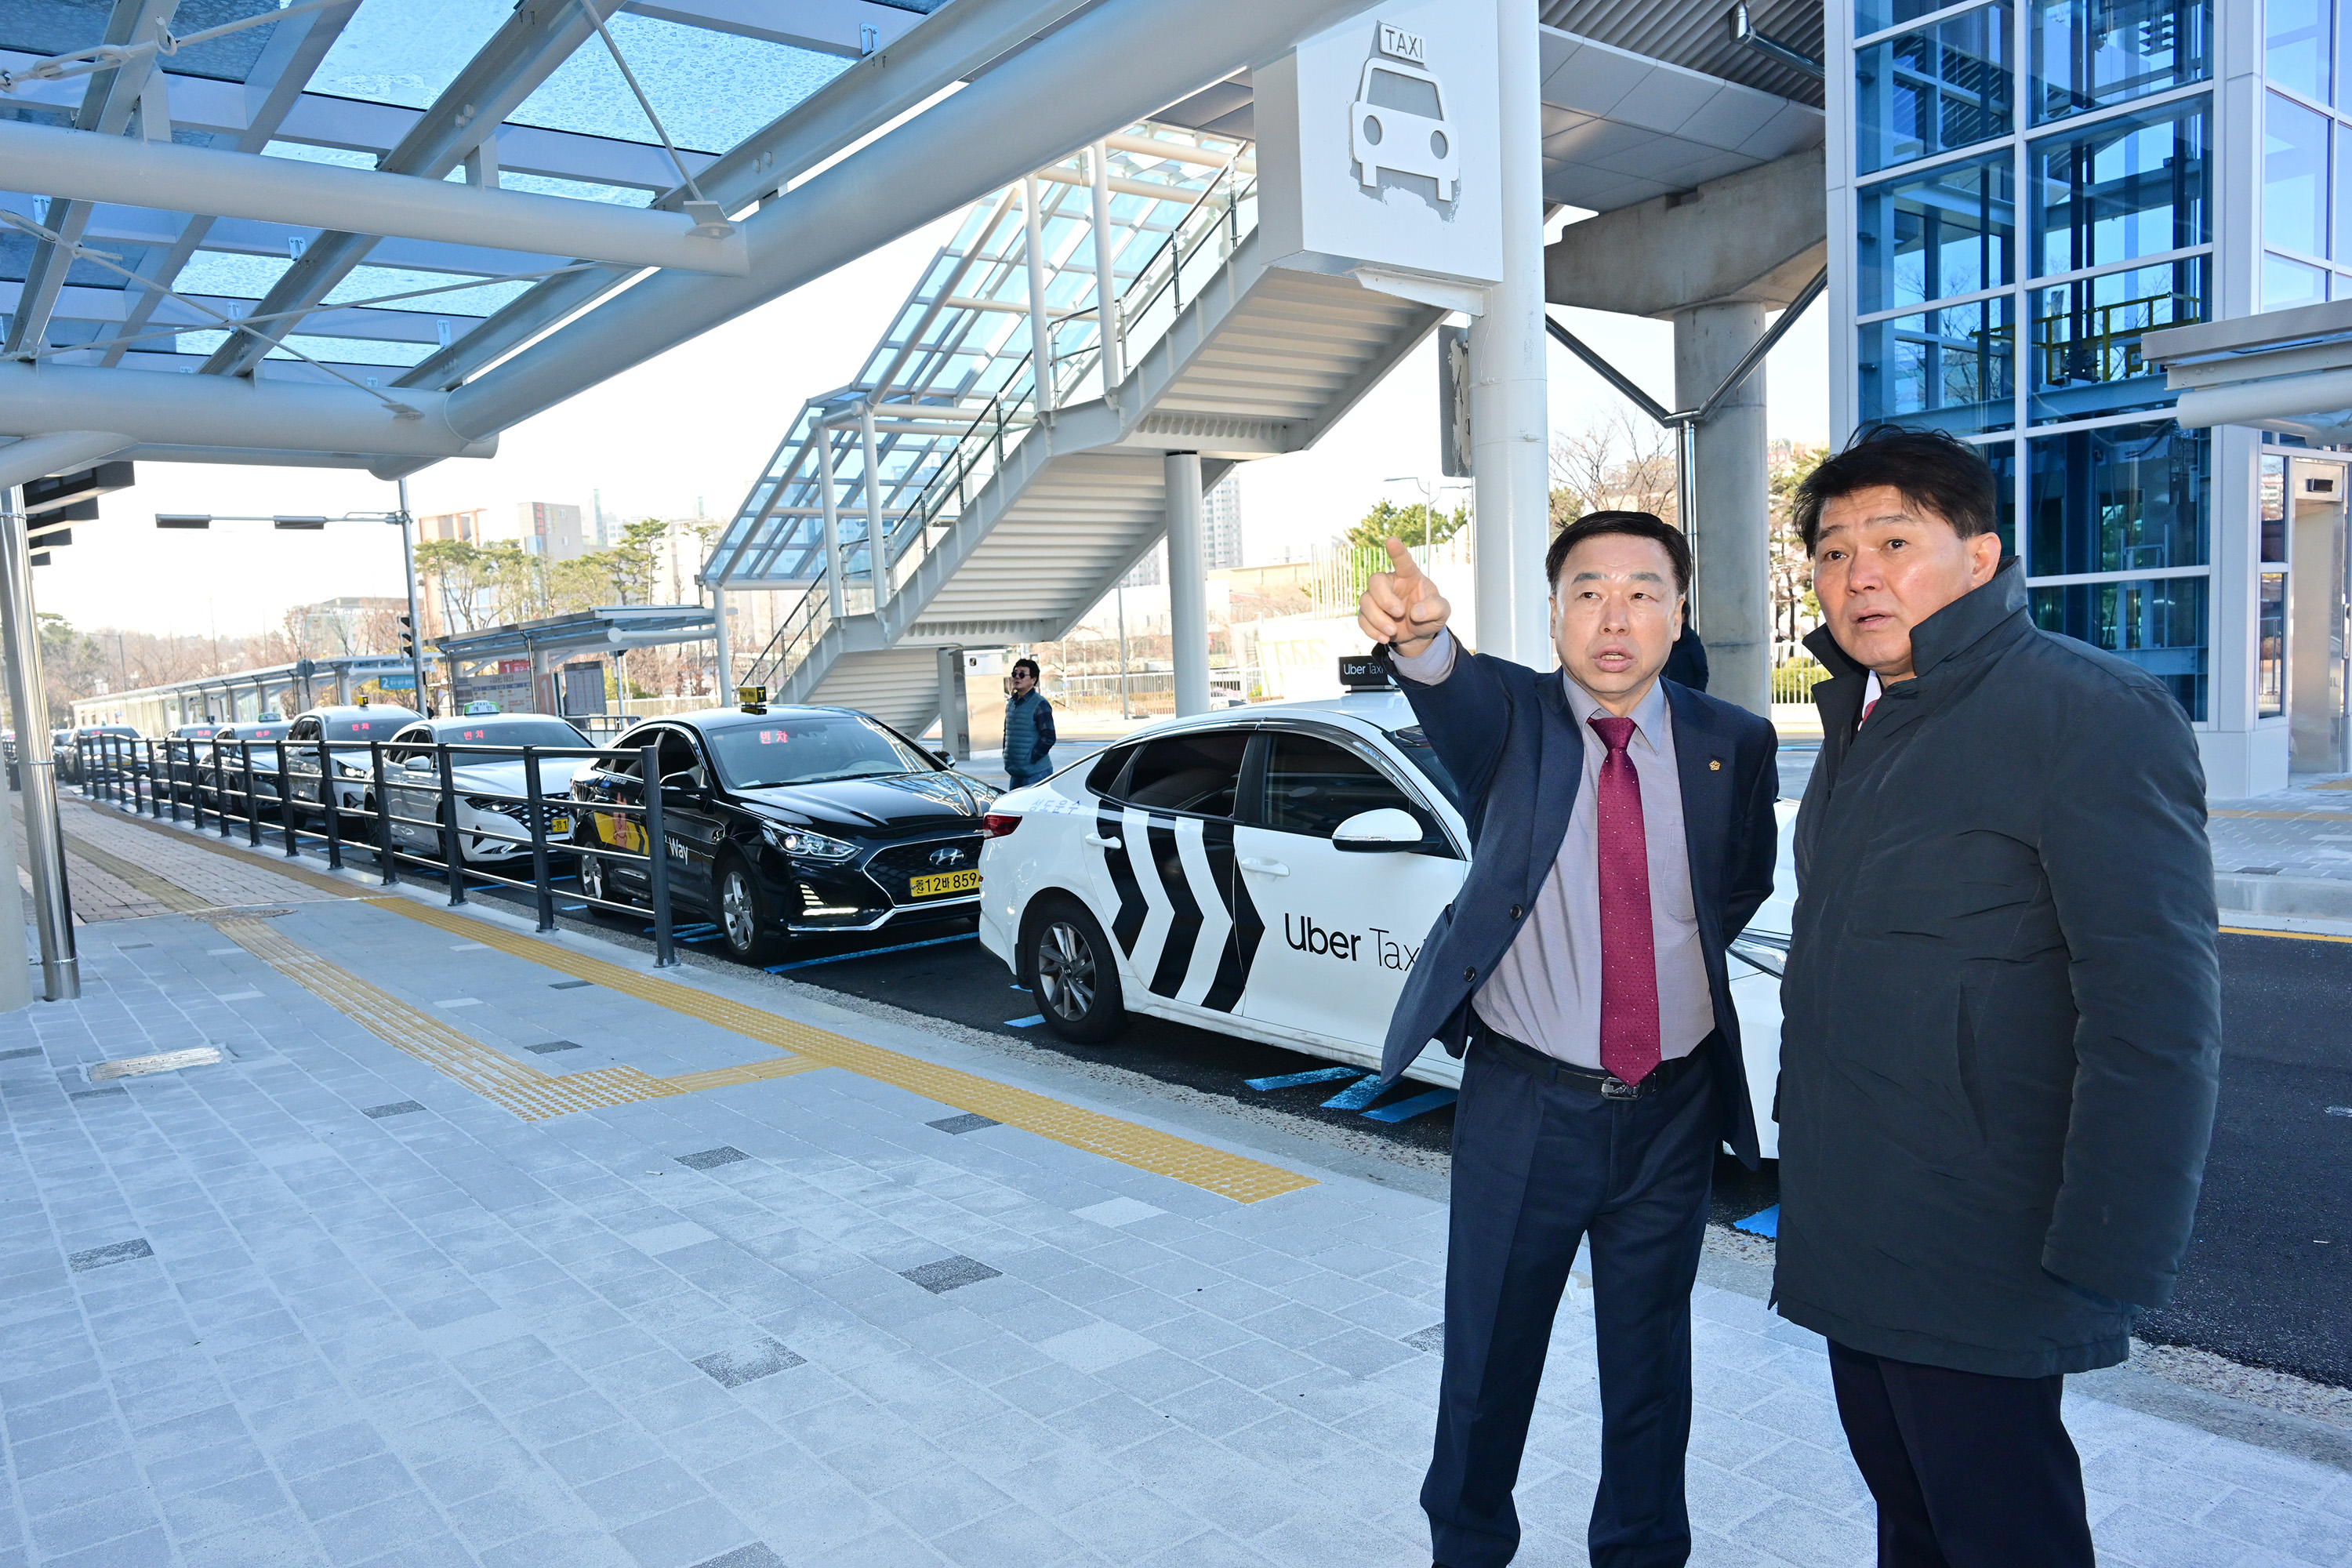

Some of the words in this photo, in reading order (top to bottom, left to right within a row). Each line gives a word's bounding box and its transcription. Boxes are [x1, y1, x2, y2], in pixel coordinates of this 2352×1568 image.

[1385, 28, 1423, 59] TAXI
[1343, 663, 1366, 675] Uber
[382, 677, 390, 688] 2
[758, 689, 765, 699] T
[669, 837, 688, 866] Way
[953, 872, 981, 889] 859
[1284, 913, 1362, 962] Uber
[1369, 927, 1427, 972] Tax
